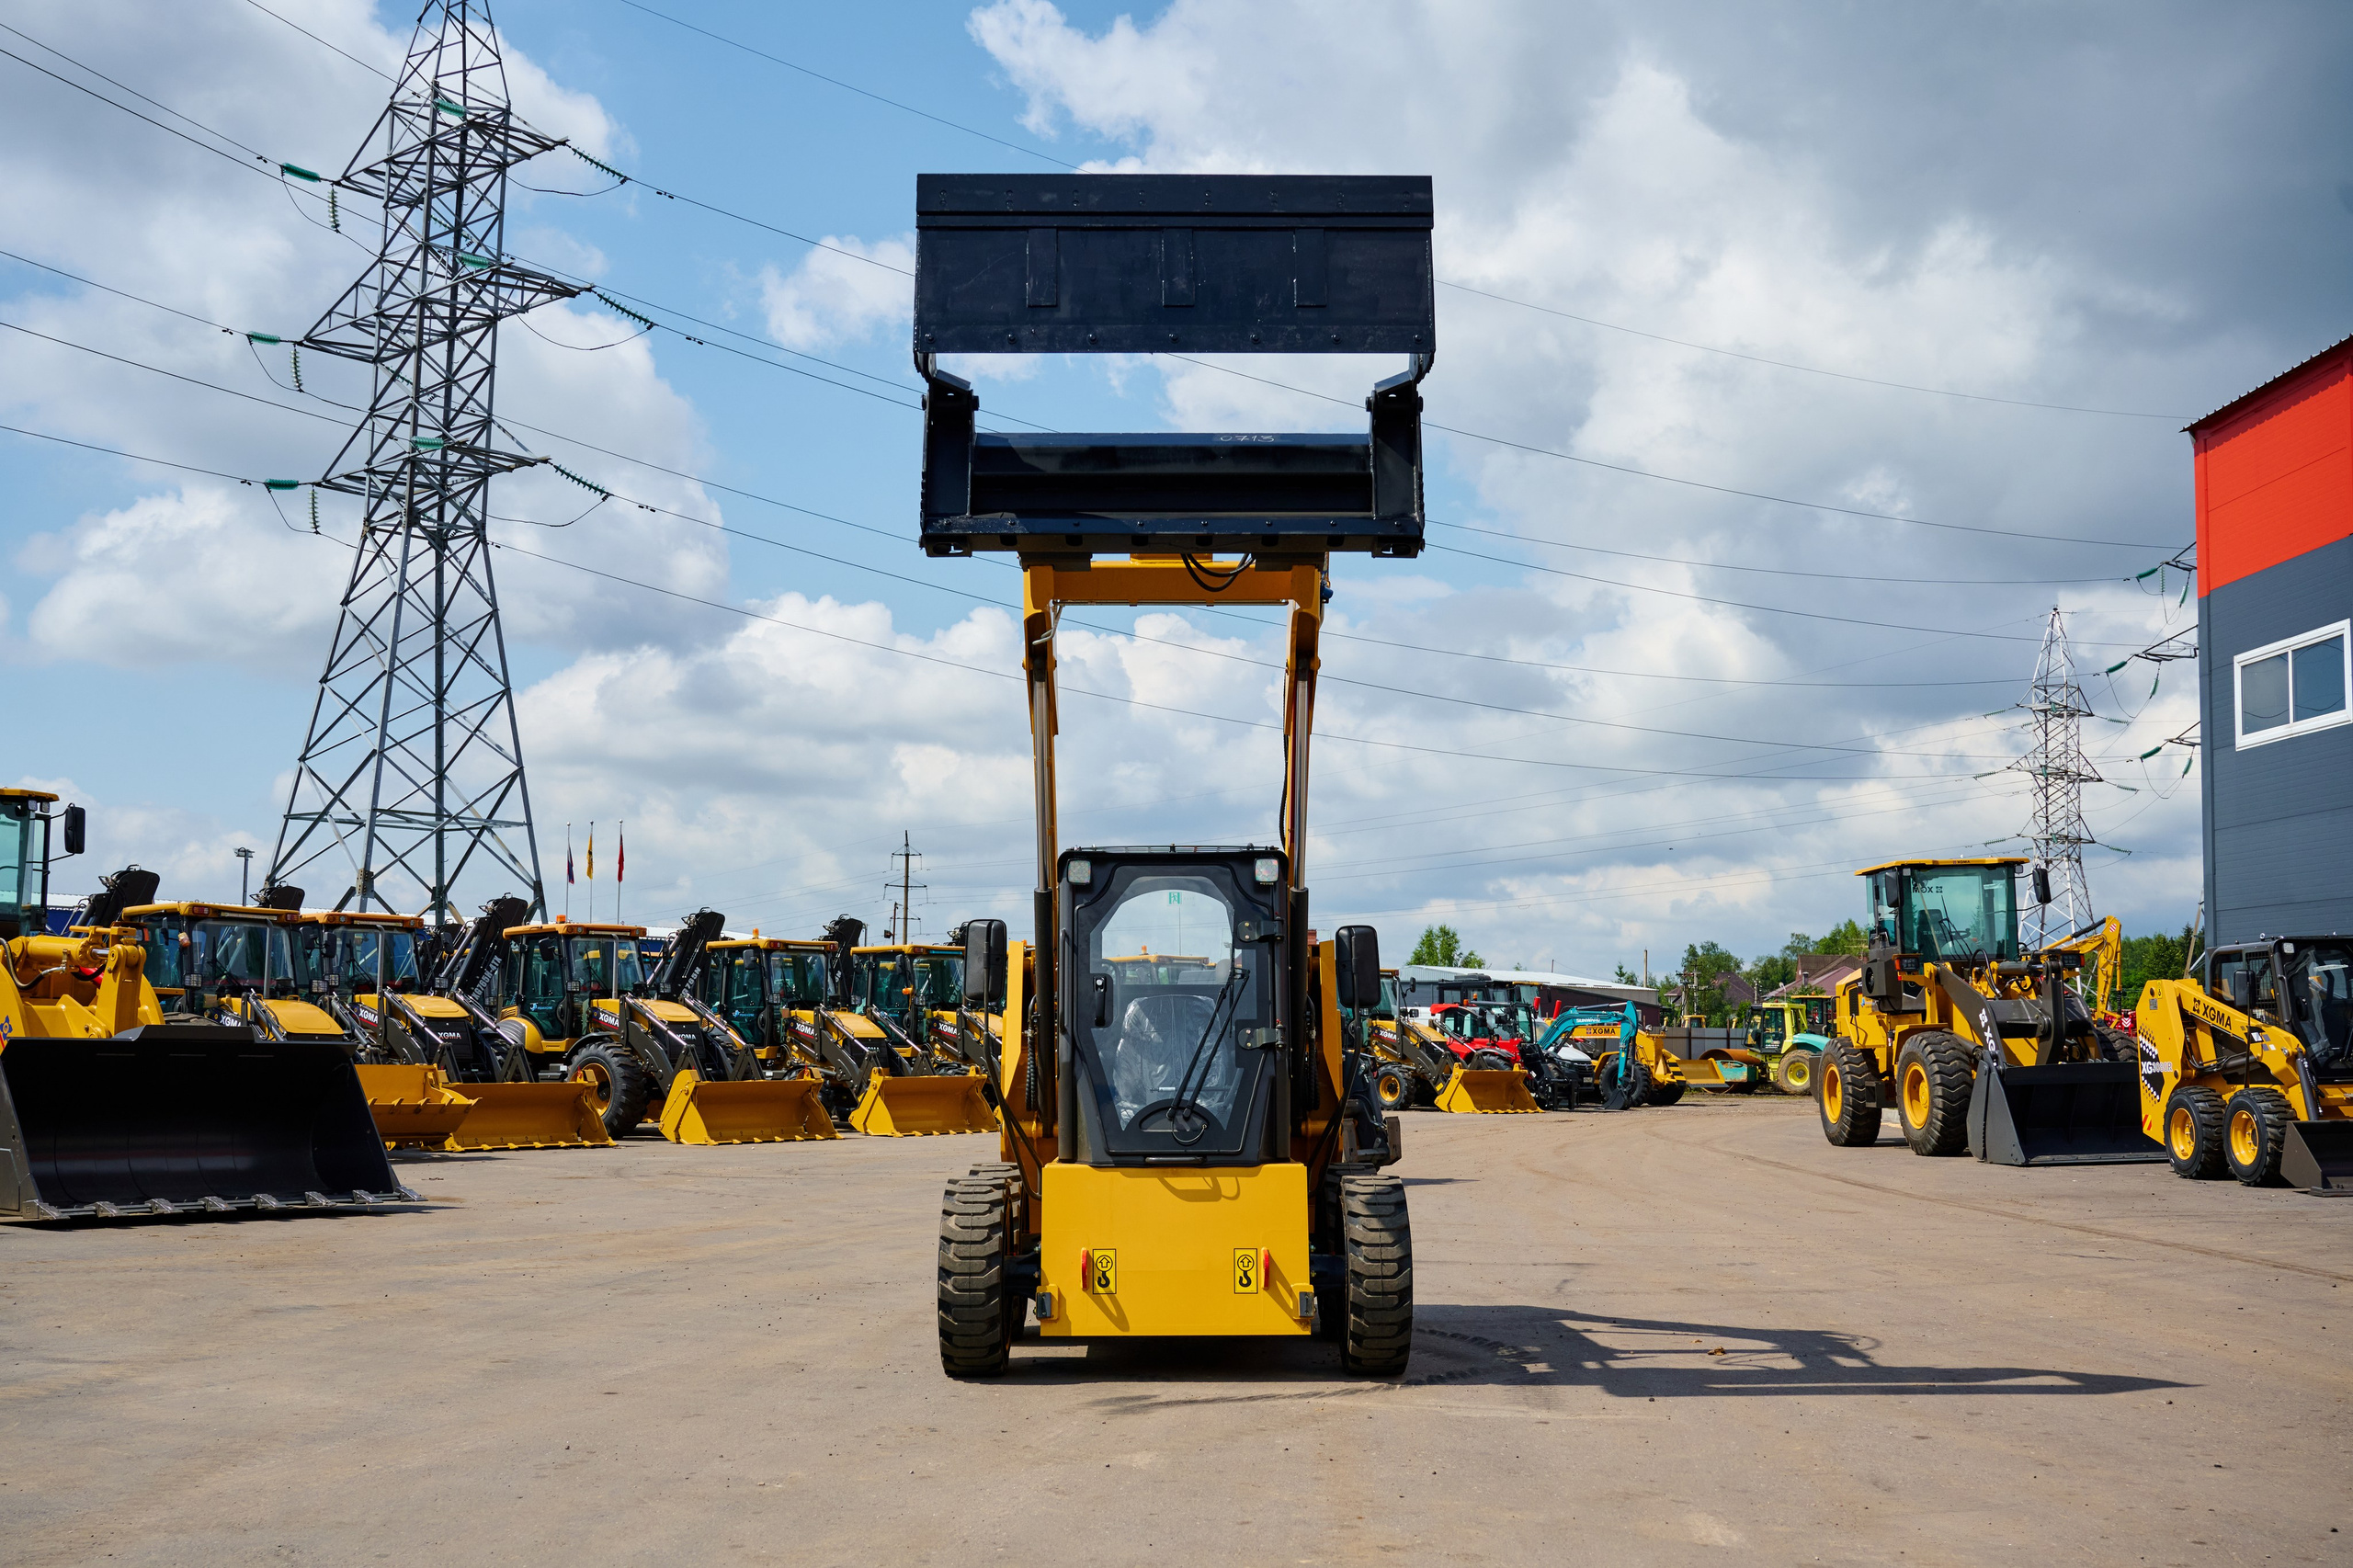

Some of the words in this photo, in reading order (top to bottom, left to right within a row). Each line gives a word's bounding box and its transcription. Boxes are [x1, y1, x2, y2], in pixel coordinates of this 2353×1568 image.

[1220, 435, 1275, 443] 0713
[358, 1007, 379, 1024] XGMA
[598, 1012, 620, 1028] XGMA
[2202, 1003, 2233, 1030] XGMA
[795, 1022, 815, 1036] XGMA
[938, 1022, 958, 1035] XGMA
[1379, 1029, 1397, 1040] XGMA
